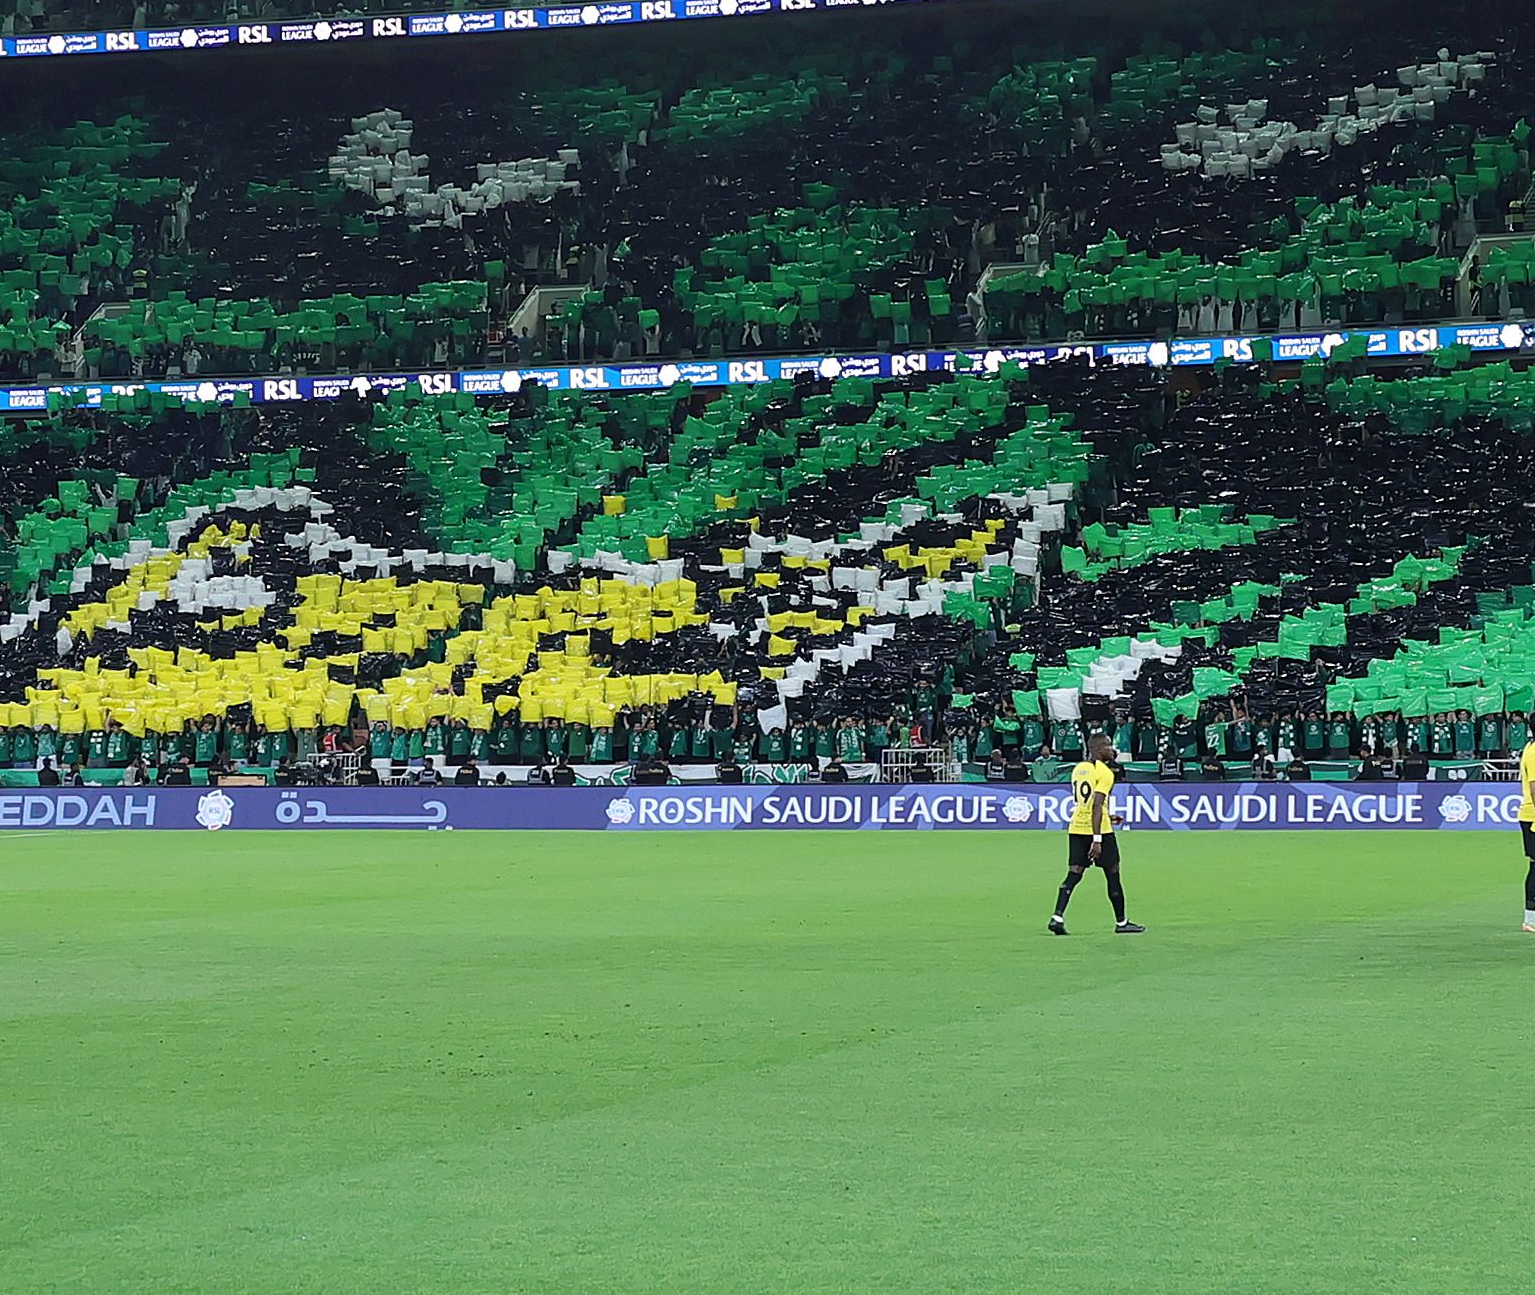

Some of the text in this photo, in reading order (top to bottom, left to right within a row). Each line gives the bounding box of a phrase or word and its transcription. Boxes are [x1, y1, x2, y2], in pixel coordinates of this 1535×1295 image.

[504, 8, 538, 29] RSL
[641, 0, 676, 19] RSL
[238, 24, 272, 44] RSL
[372, 17, 406, 37] RSL
[106, 31, 140, 50] RSL
[1112, 350, 1148, 364] EAGUE
[1223, 336, 1252, 359] RS
[569, 366, 610, 389] RSL
[620, 373, 659, 386] LEAGUE
[728, 360, 770, 383] RSL
[264, 379, 302, 400] RSL
[463, 379, 501, 392] LEAGUE
[1072, 779, 1092, 803] 19
[639, 796, 997, 823] ROSHN SAUDI LEAGUE
[1171, 794, 1276, 822] SAUDI
[1288, 794, 1422, 822] LEAGUE
